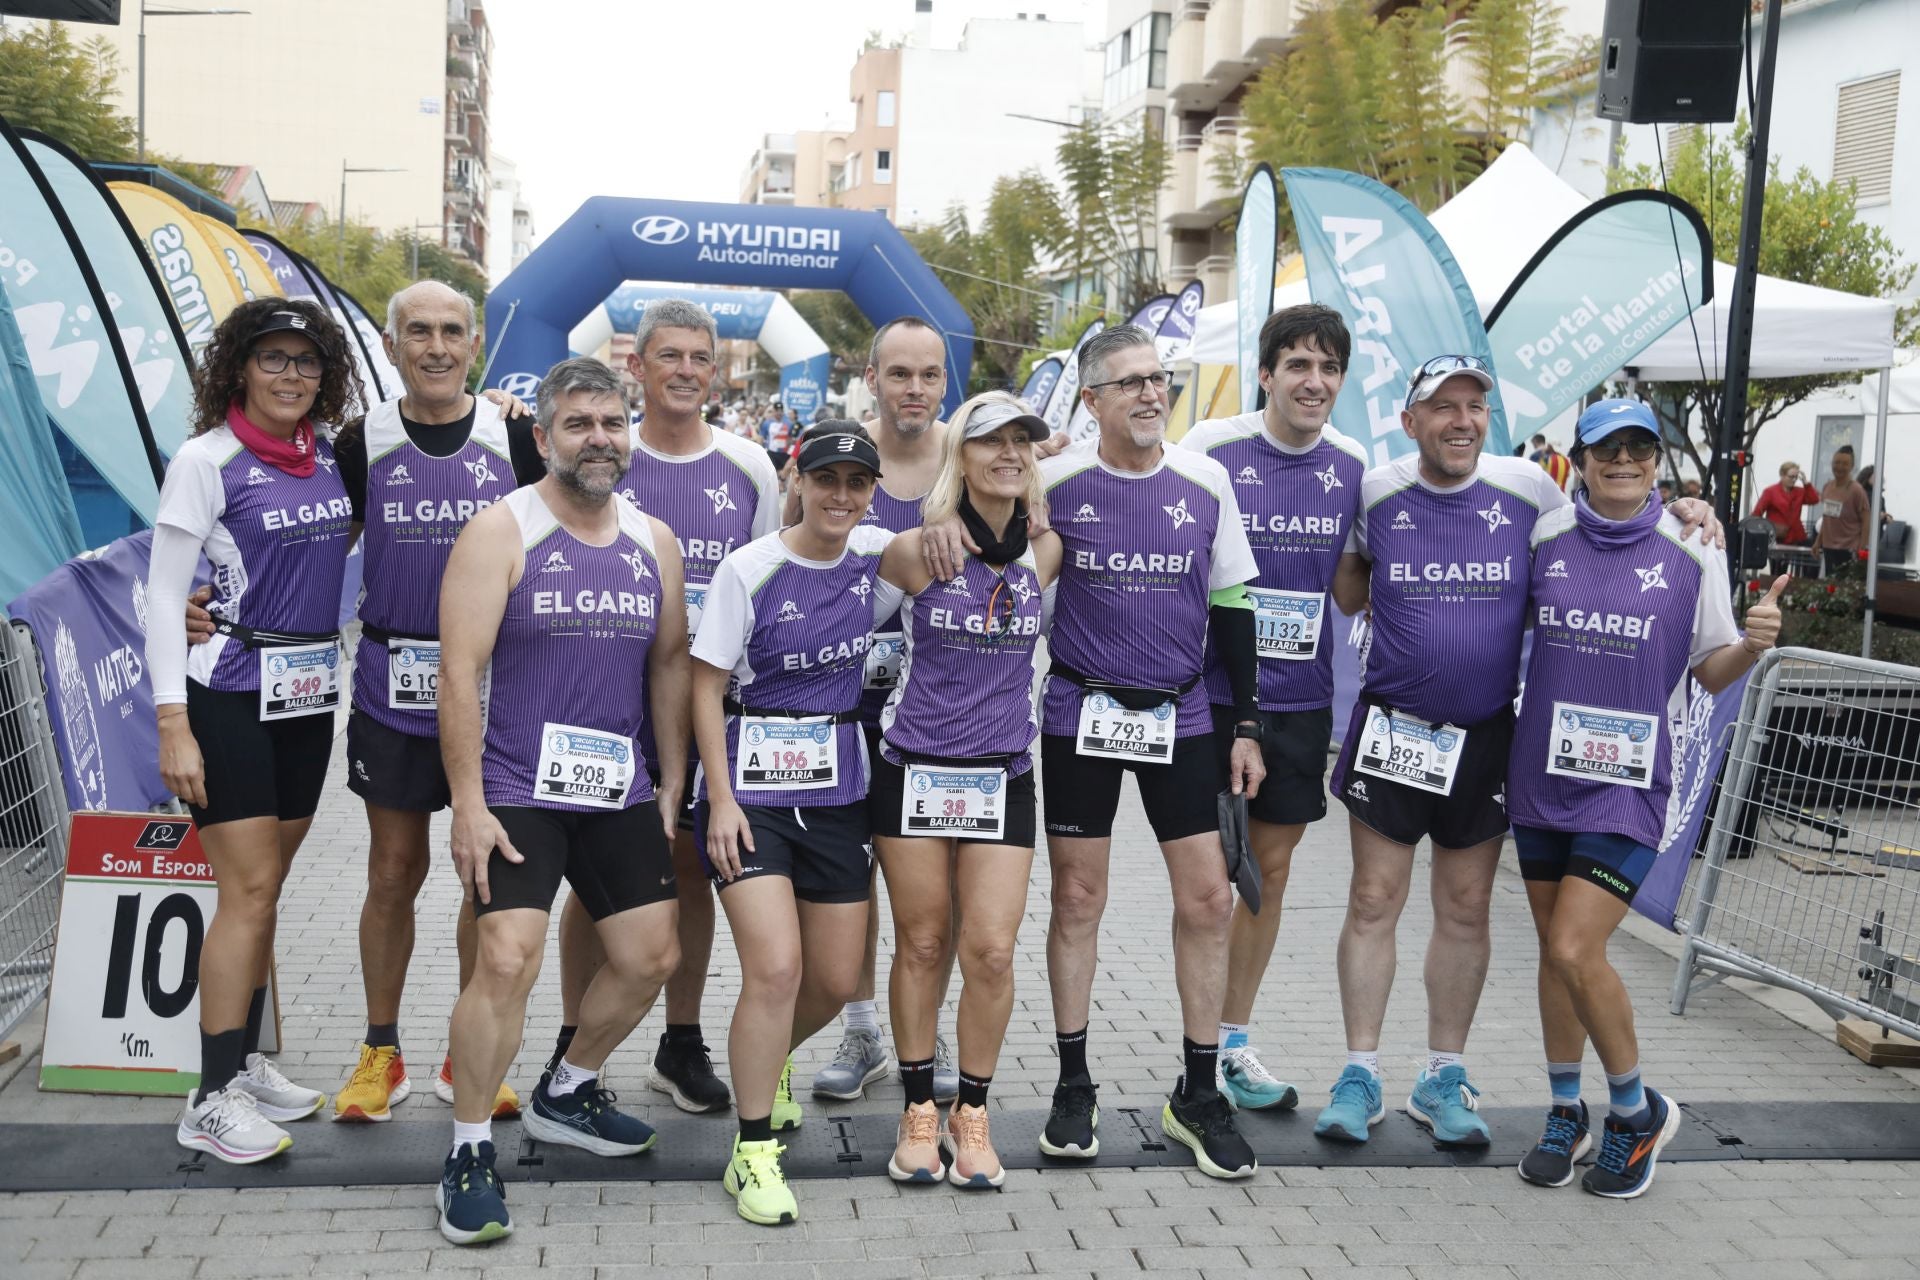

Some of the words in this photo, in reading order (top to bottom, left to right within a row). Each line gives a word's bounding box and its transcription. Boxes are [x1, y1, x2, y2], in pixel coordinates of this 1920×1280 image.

[698, 222, 840, 251] HYUNDAI
[698, 245, 839, 269] Autoalmenar
[711, 303, 742, 316] PEU
[1515, 294, 1600, 370] Portal
[1537, 357, 1573, 390] de
[1570, 332, 1605, 361] la
[1601, 258, 1697, 336] Marina
[262, 507, 297, 531] EL
[298, 496, 353, 525] GARB
[383, 501, 412, 523] EL
[416, 495, 501, 522] GAR
[395, 527, 424, 535] CLUB
[428, 527, 442, 535] DE
[1241, 514, 1265, 532] EL
[1269, 514, 1342, 535] GARBÍ
[311, 534, 330, 542] 1995
[678, 538, 735, 560] ARBÍ
[1075, 550, 1104, 570] EL
[1108, 550, 1193, 574] GARBÍ
[1389, 563, 1419, 581] EL
[1423, 556, 1512, 582] GARBÍ
[1088, 575, 1115, 583] CLUB
[1138, 577, 1181, 585] CORRER
[1123, 585, 1146, 593] 1995
[533, 591, 573, 614] EL
[576, 589, 655, 619] GARBÍ
[551, 619, 582, 627] CLUB
[587, 619, 602, 627] DE
[929, 607, 960, 630] EL
[964, 608, 1041, 636] GARBÍ
[1258, 620, 1301, 639] 1132
[1538, 606, 1562, 628] EL
[1565, 609, 1656, 640] GARBÍ
[589, 630, 615, 639] 1995
[1546, 630, 1570, 640] CLUB
[1574, 634, 1589, 643] DE
[1594, 636, 1637, 650] CORRER
[288, 654, 310, 662] CIRCUIT
[784, 653, 815, 672] EL
[818, 631, 874, 662] GARB
[975, 647, 999, 655] 1995
[1576, 645, 1600, 655] 1995
[400, 673, 412, 688] G
[876, 665, 888, 677] D
[272, 682, 282, 697] C
[291, 676, 321, 697] 349
[1393, 720, 1416, 731] CIRCUIT
[1581, 715, 1606, 725] CIRCUIT
[1091, 719, 1101, 735] E
[1110, 721, 1145, 741] 793
[1402, 735, 1421, 744] DAVID
[1587, 729, 1619, 739] SAGRARIO
[571, 736, 596, 744] CIRCUIT
[1370, 740, 1380, 755] E
[568, 750, 589, 758] MARCO
[589, 753, 615, 761] ANTONIO
[748, 752, 760, 767] A
[772, 751, 808, 769] 196
[1561, 738, 1573, 754] D
[1582, 740, 1619, 763] 353
[549, 761, 562, 777] D
[572, 764, 606, 785] 908
[915, 799, 925, 815] E
[942, 798, 966, 817] 38
[1592, 866, 1629, 894] HANKER
[102, 892, 205, 1018] 10
